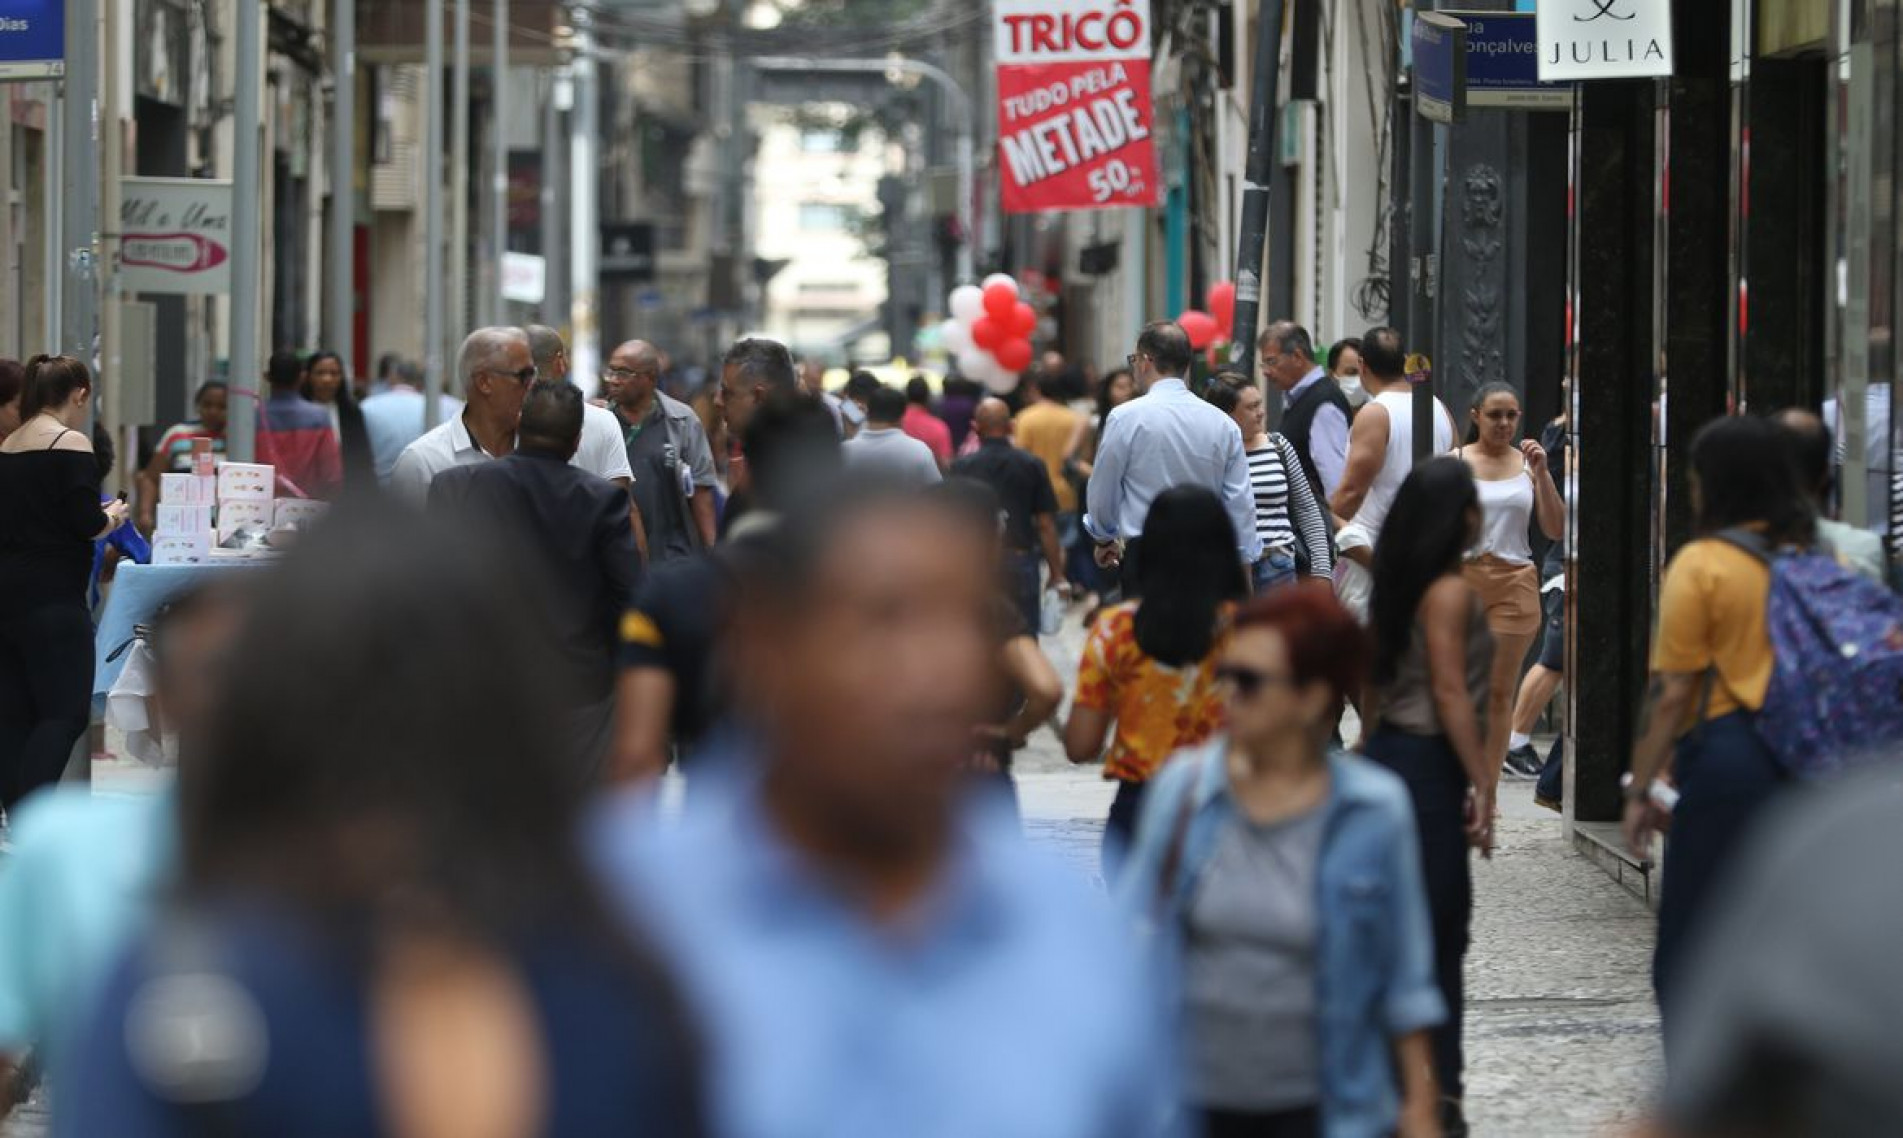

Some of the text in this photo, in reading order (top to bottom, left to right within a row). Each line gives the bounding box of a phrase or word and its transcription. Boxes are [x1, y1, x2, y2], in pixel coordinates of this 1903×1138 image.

[1003, 0, 1143, 53] TRICÔ
[1466, 21, 1485, 34] ua
[1466, 38, 1538, 57] onçalve
[1547, 38, 1664, 64] JULIA
[1003, 62, 1127, 120] TUDO PELA
[1001, 88, 1148, 187] METADE
